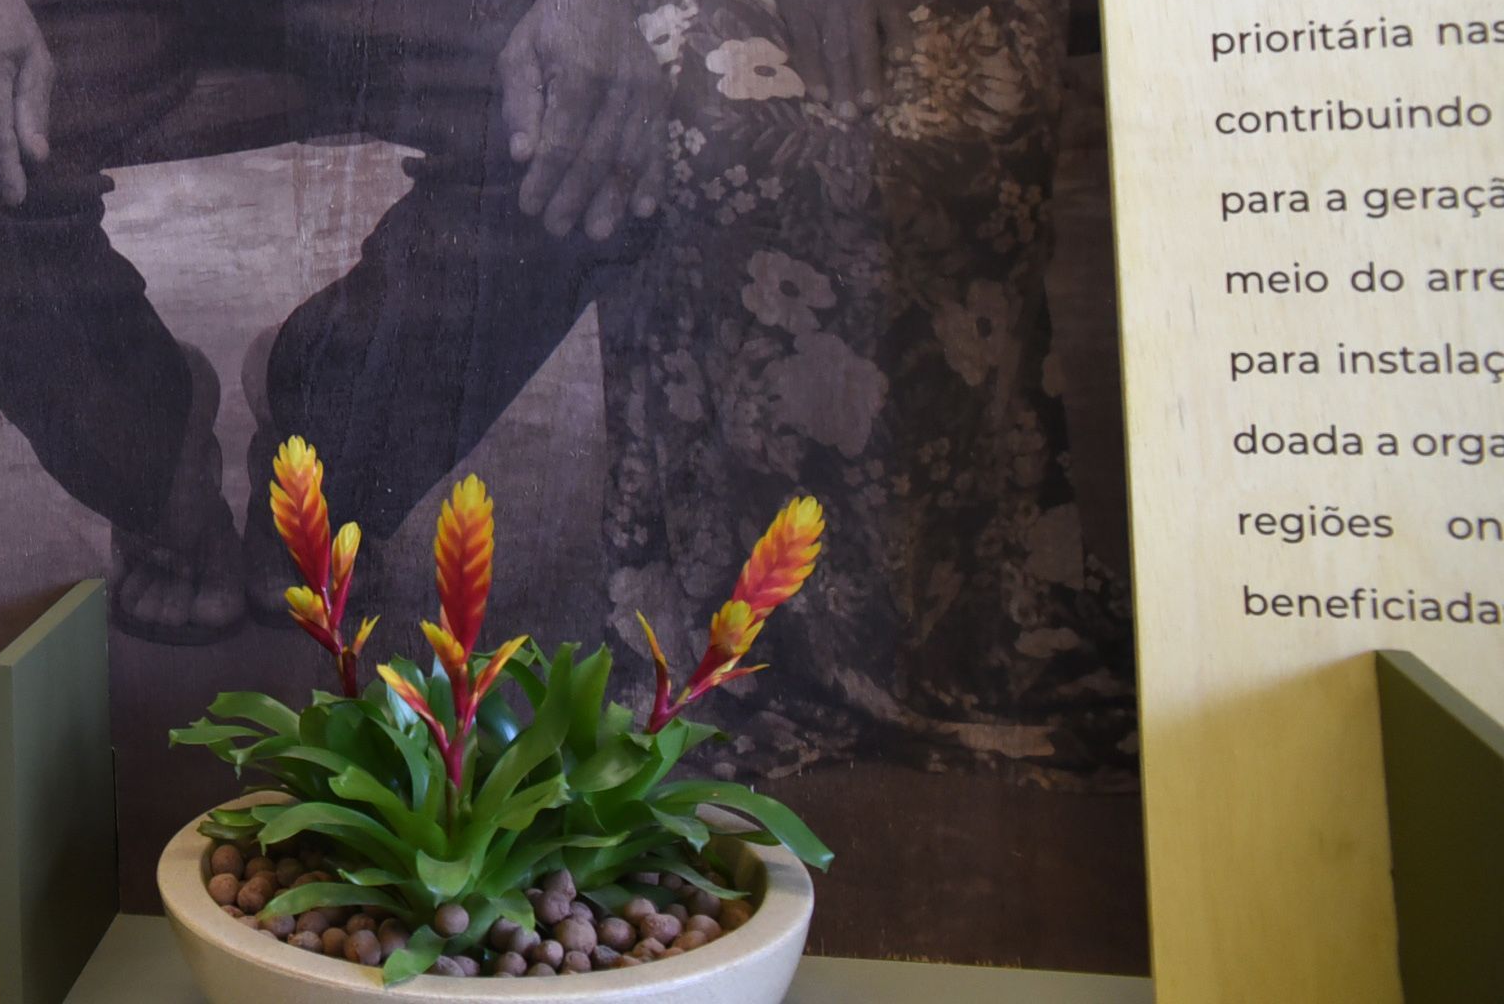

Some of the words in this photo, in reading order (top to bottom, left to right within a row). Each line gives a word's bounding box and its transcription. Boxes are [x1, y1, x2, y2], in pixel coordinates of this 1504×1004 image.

[1211, 16, 1414, 63] prioritária
[1214, 95, 1492, 135] contribuindo
[1220, 189, 1310, 223] para
[1326, 188, 1348, 212] a
[1225, 261, 1329, 295] meio
[1350, 261, 1405, 293] do
[1427, 267, 1504, 292] arre
[1230, 351, 1320, 383] para
[1337, 342, 1504, 384] instalaç
[1233, 423, 1364, 456] doada
[1377, 432, 1399, 457] a
[1412, 433, 1504, 466] orga
[1238, 504, 1394, 545] regiões
[1447, 516, 1504, 541] on
[1243, 584, 1504, 625] beneficiada
